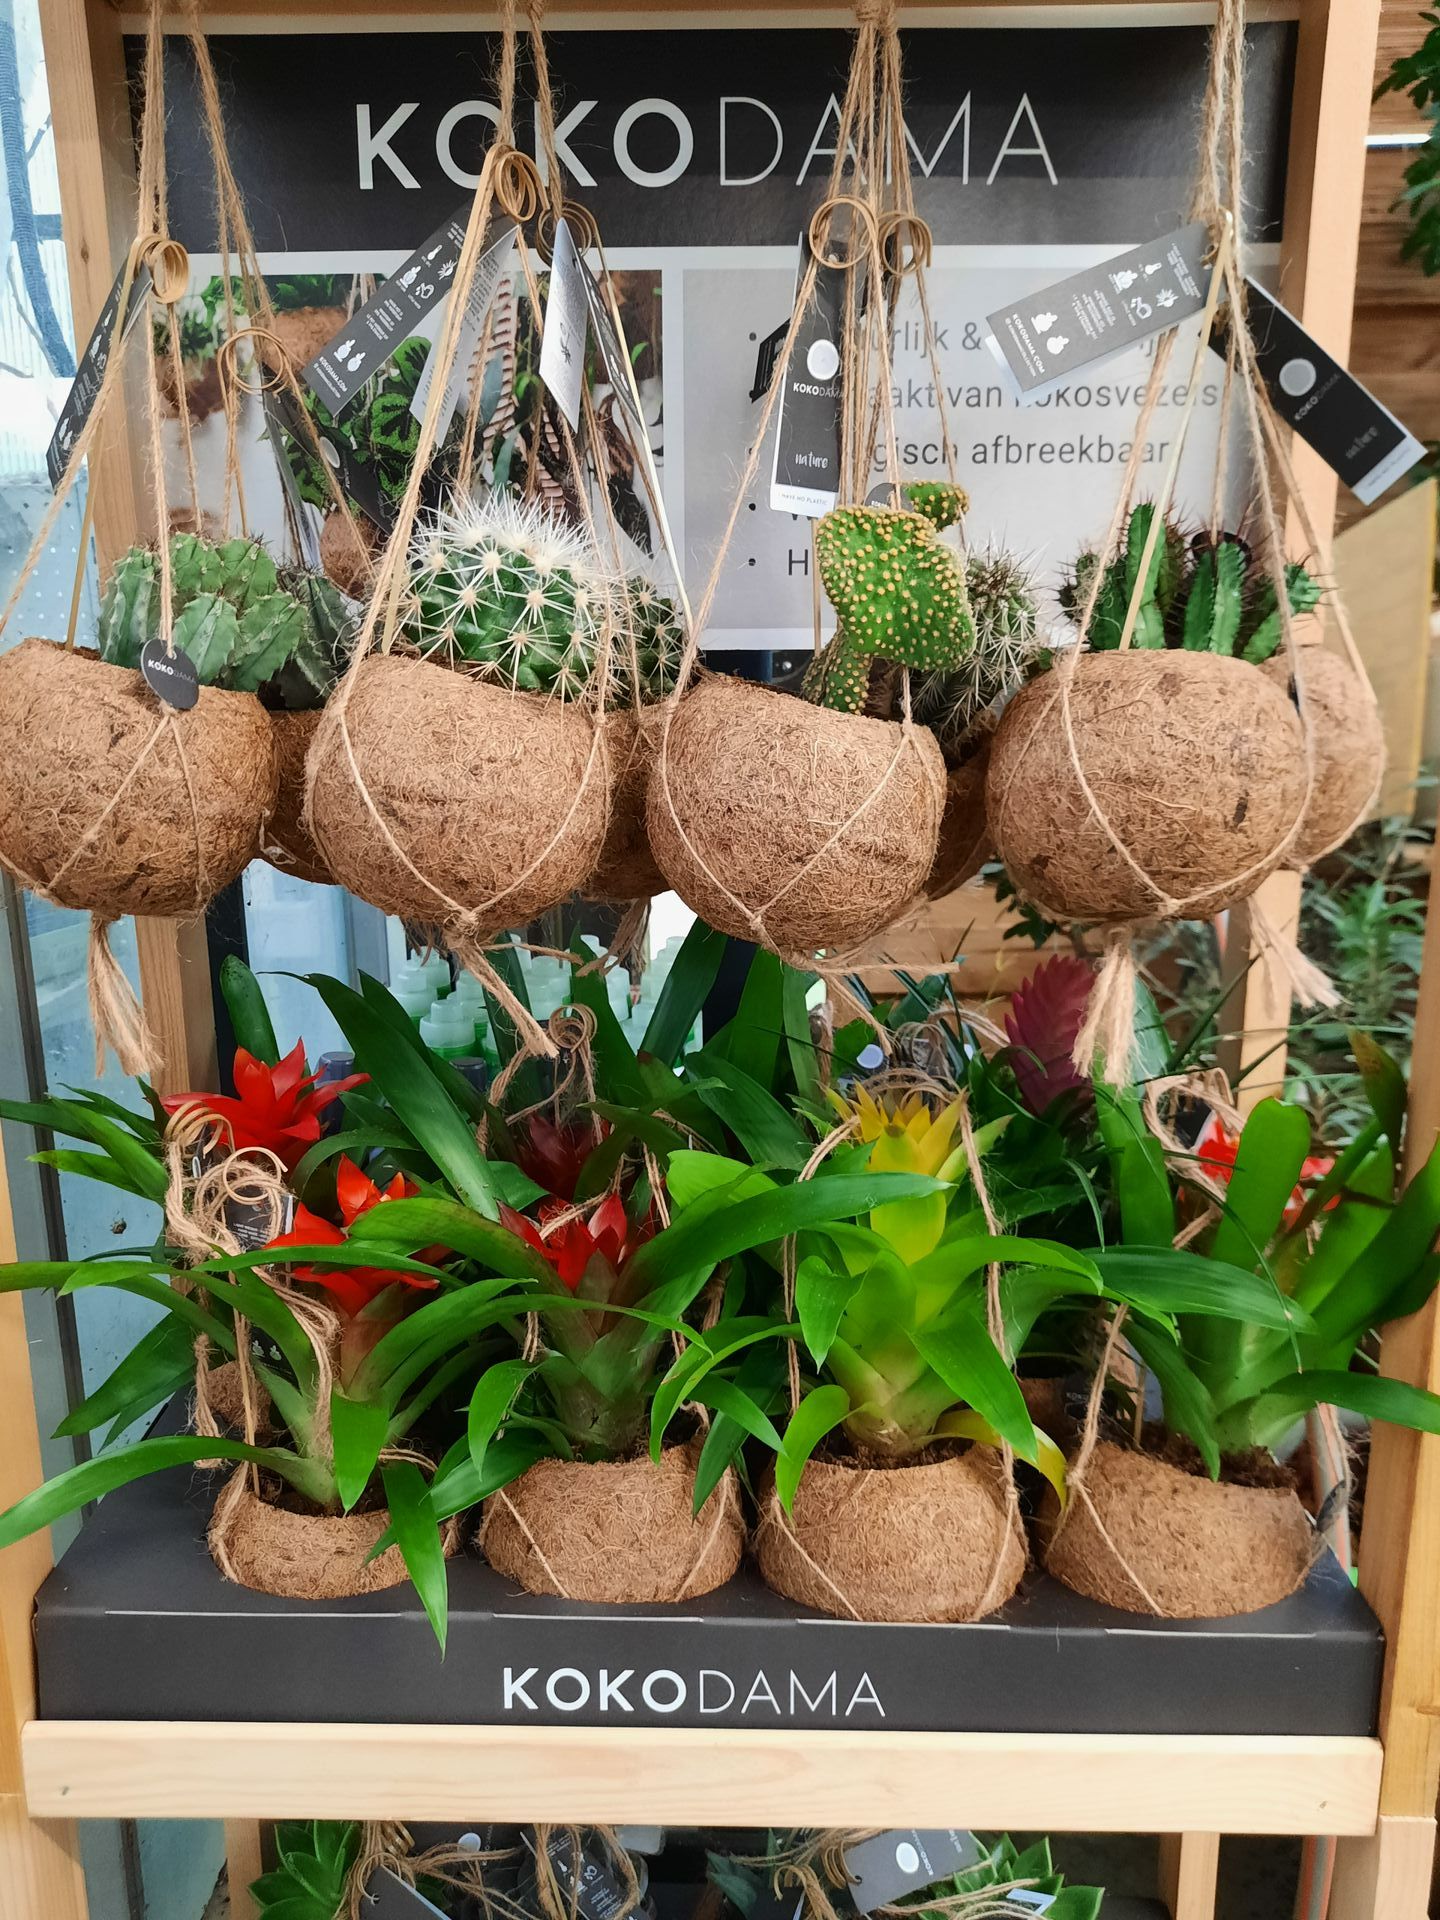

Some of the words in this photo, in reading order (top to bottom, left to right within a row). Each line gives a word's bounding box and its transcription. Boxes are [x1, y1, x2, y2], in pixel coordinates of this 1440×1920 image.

[356, 91, 1058, 191] KOKODAMA
[961, 321, 982, 351] &
[946, 386, 1002, 408] van
[795, 451, 830, 469] nature
[971, 434, 1170, 465] afbreekbaar
[503, 1667, 886, 1717] KOKODAMA
